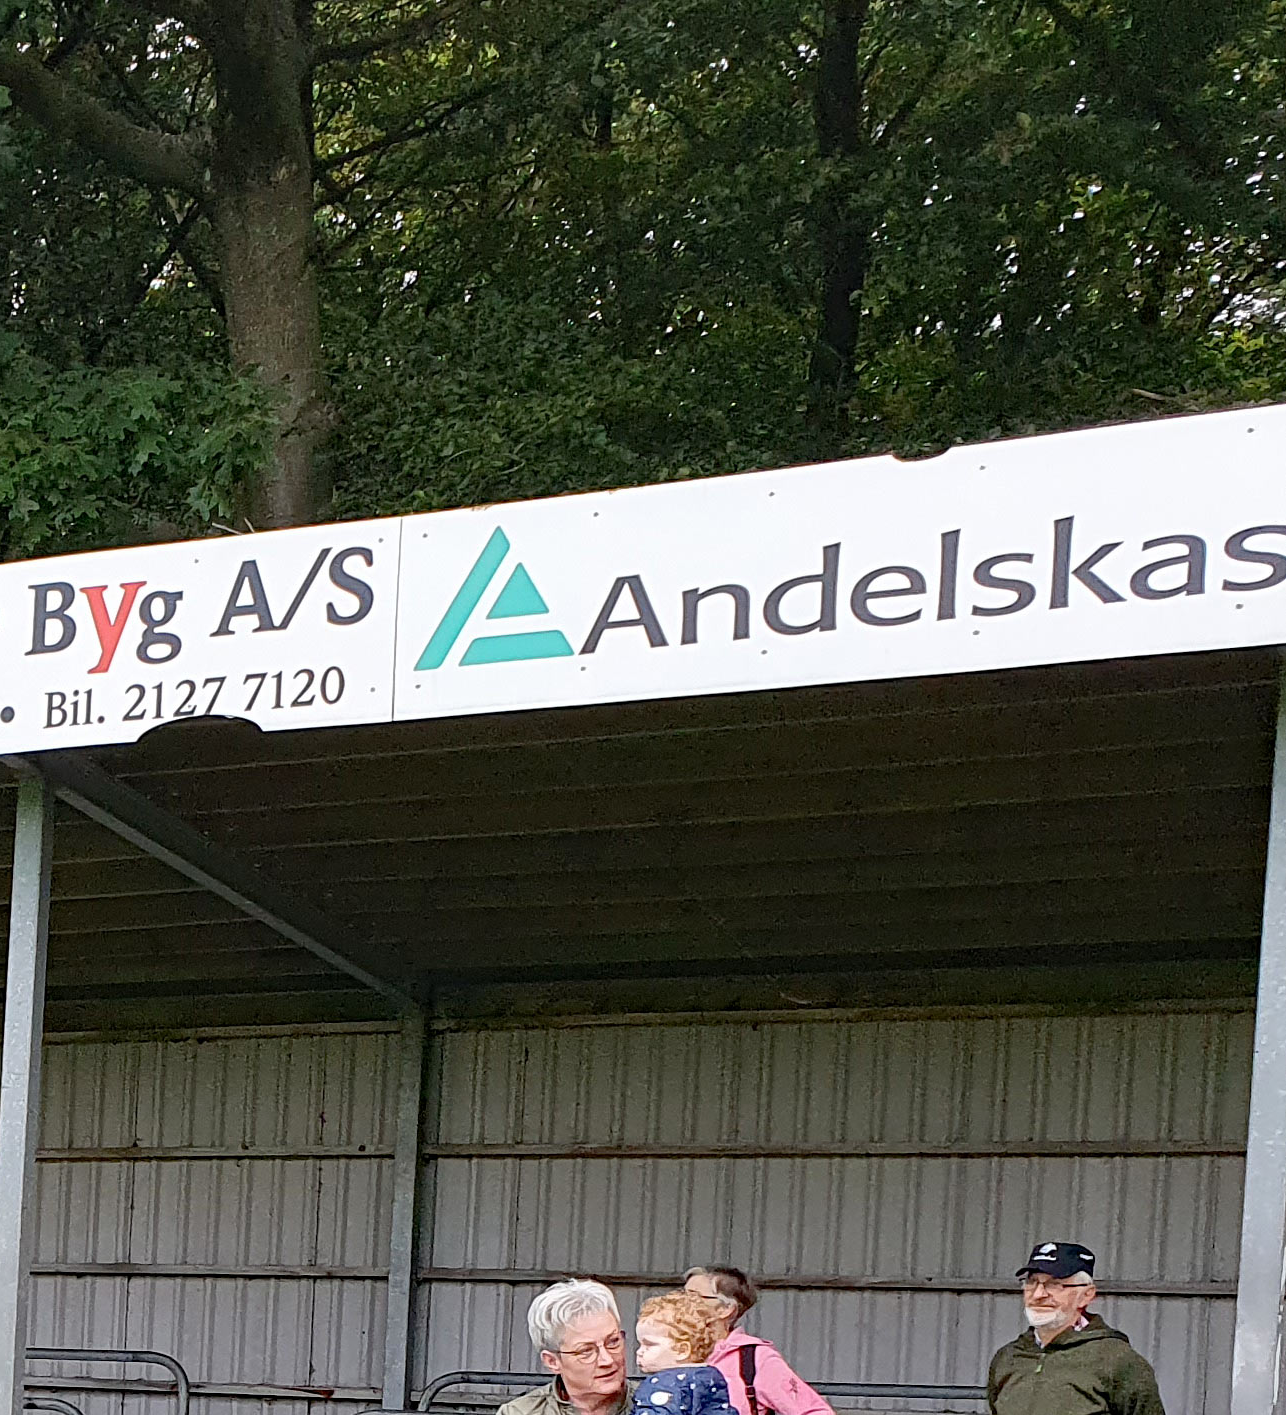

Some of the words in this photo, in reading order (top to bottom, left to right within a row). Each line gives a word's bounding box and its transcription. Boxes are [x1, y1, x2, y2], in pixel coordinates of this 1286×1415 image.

[25, 579, 183, 674] Byg
[211, 546, 374, 637] A/S
[577, 515, 1286, 656] Andelskas
[43, 690, 105, 729] Bil.
[124, 676, 226, 721] 2127
[242, 665, 346, 712] 7120
